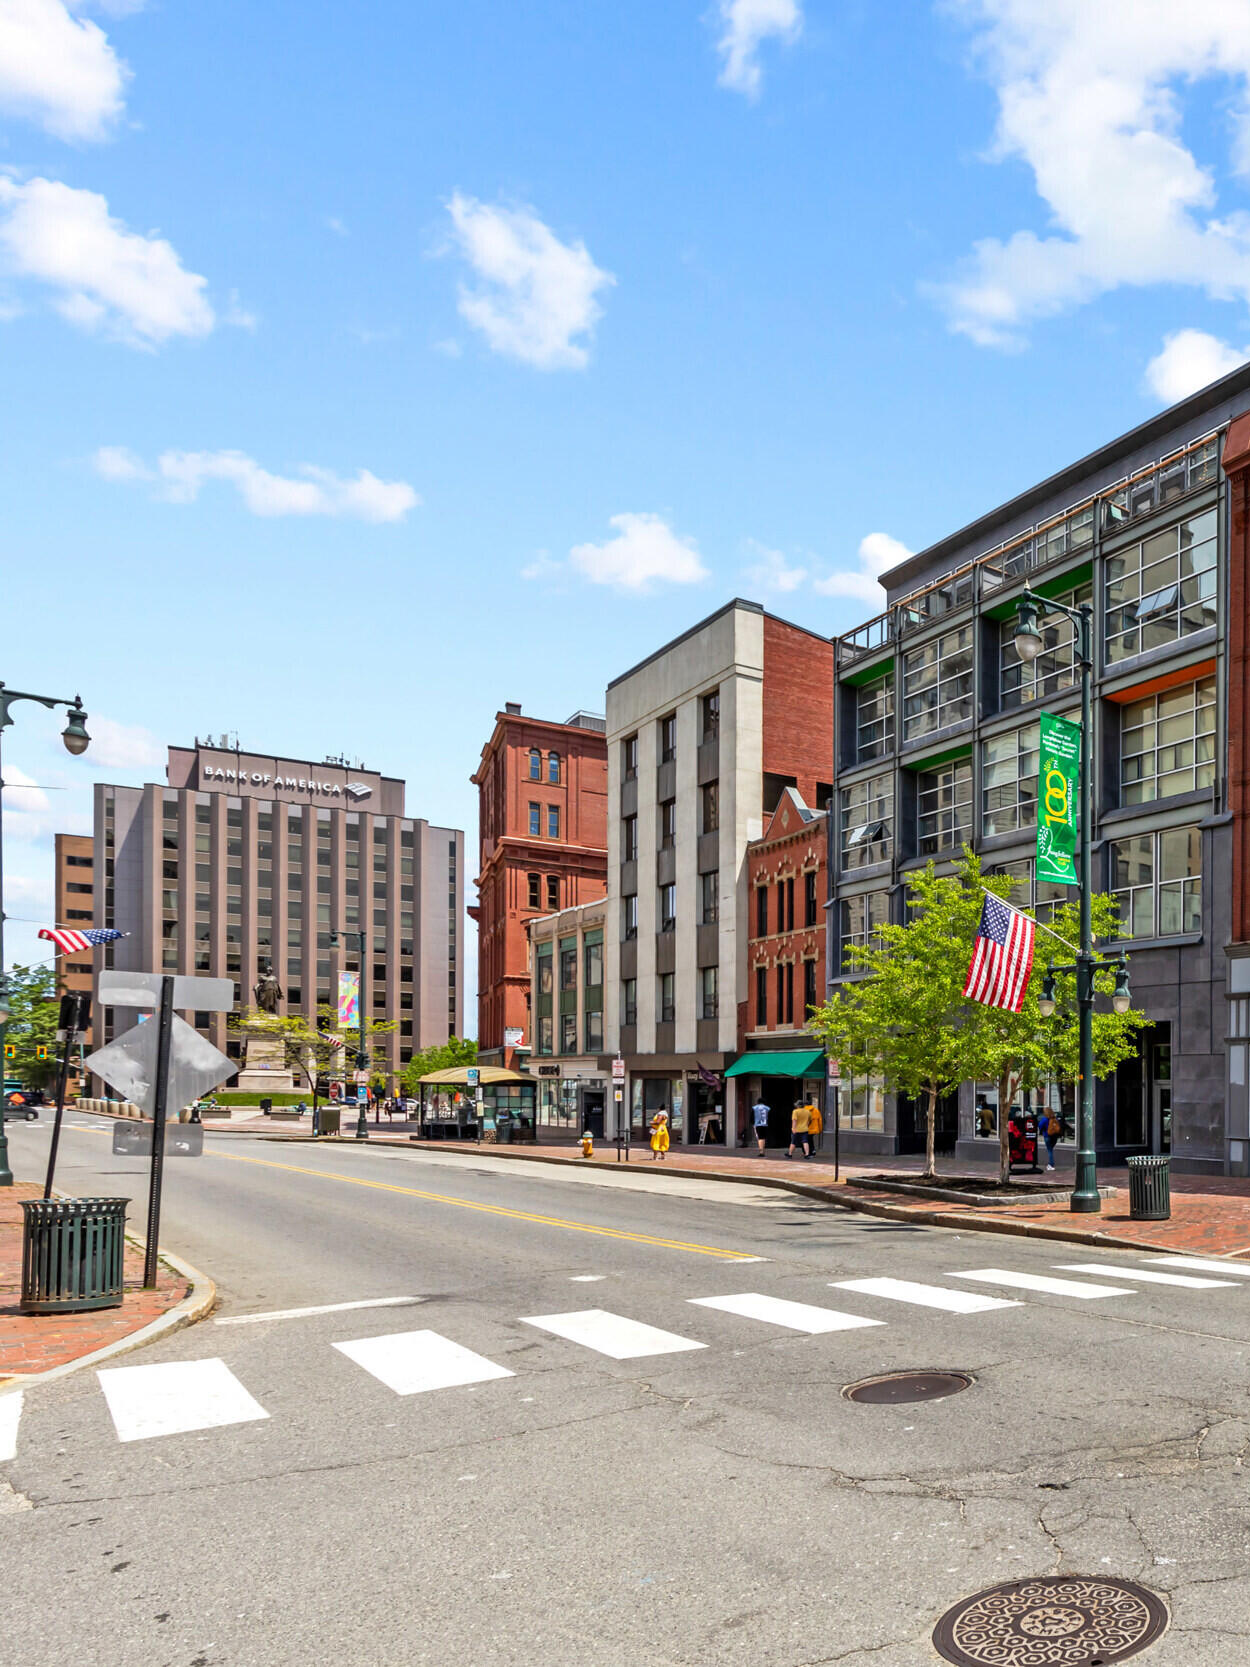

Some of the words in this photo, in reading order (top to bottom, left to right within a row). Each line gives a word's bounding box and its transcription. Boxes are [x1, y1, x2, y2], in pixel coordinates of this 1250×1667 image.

[204, 766, 248, 780] BANK
[251, 773, 271, 784] OF
[274, 776, 341, 793] AMERICA
